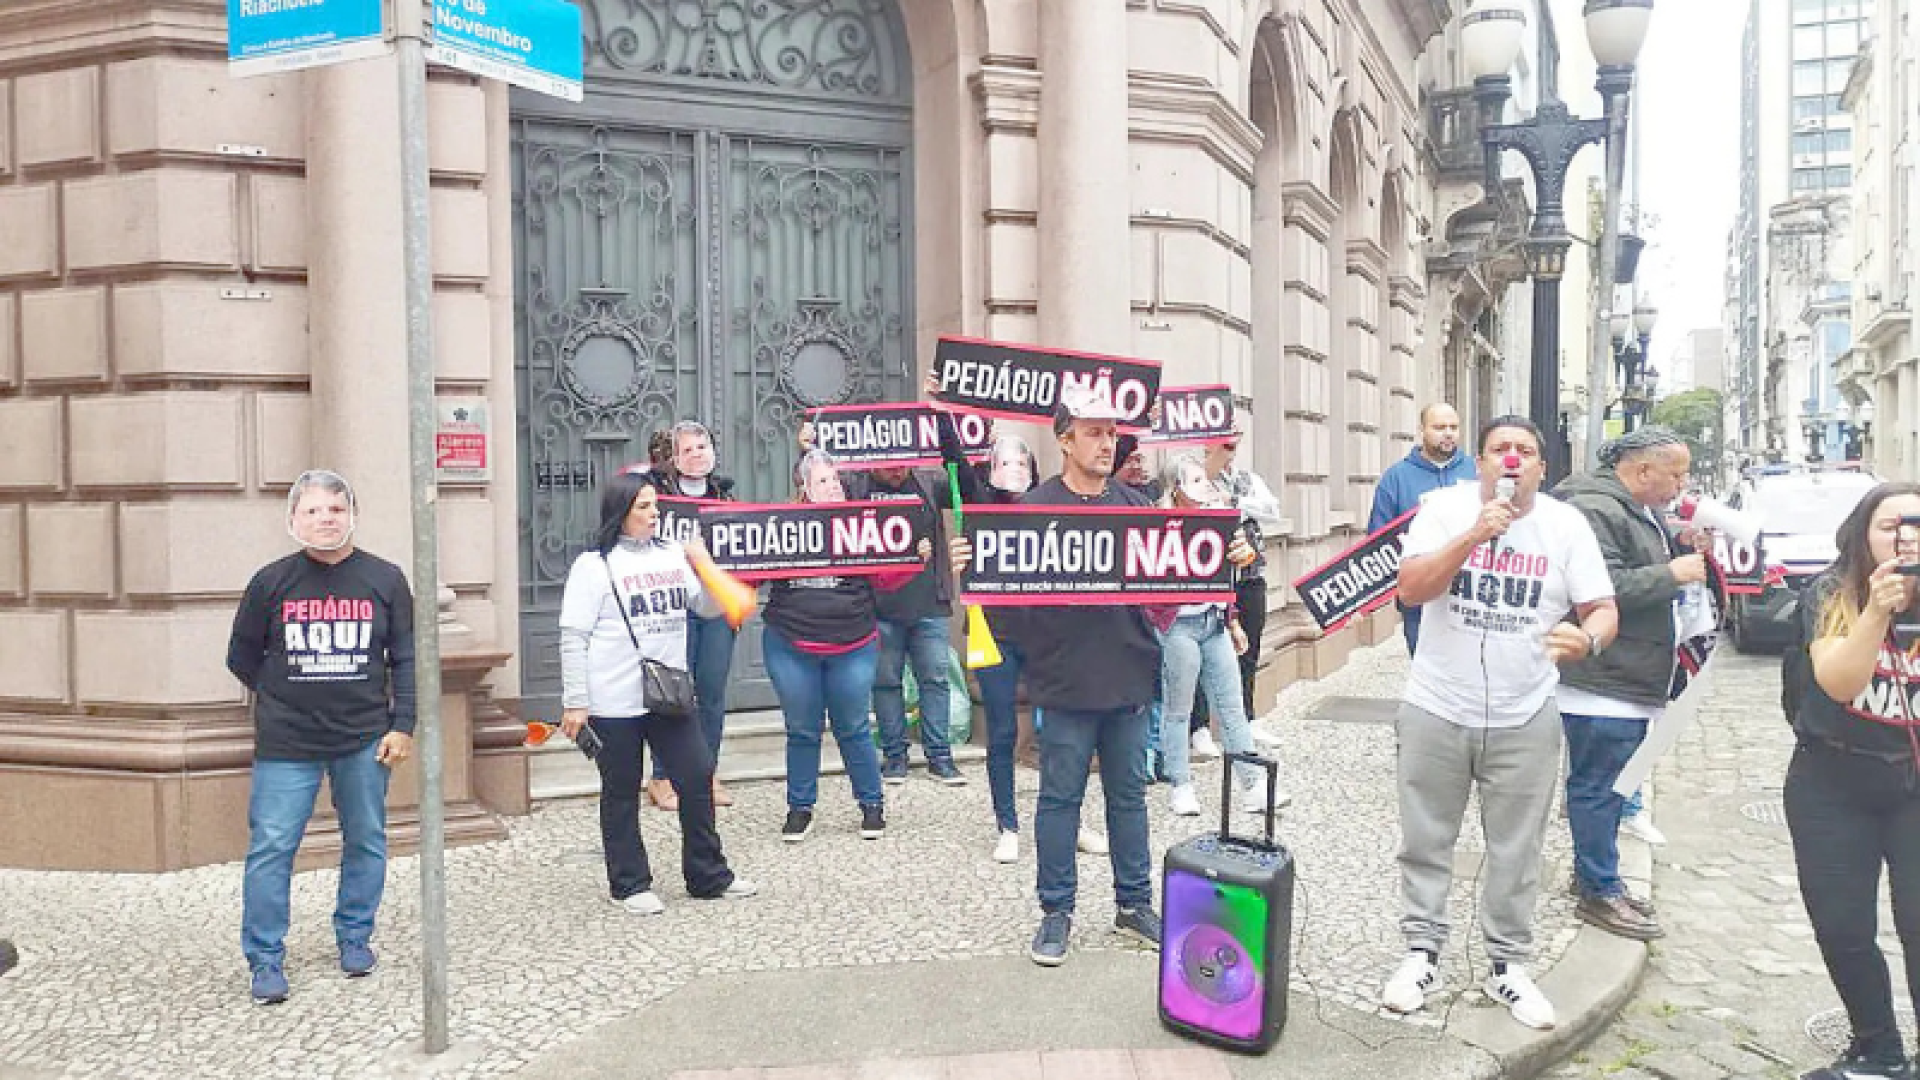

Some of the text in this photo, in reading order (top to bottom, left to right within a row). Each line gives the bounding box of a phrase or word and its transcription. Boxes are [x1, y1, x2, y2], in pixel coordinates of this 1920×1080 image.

[436, 5, 534, 52] Novembro
[941, 360, 1056, 407] PEDÁGIO
[817, 414, 985, 450] PEDÁGIO NO
[1165, 393, 1225, 431] NÃO
[712, 509, 914, 557] PEDÁGIO NÃO
[976, 518, 1226, 578] PEDÁGIO NÃO
[1308, 544, 1400, 613] PEDÁGIO
[1467, 543, 1549, 577] EDÁGIO
[282, 594, 373, 623] PEDÁGIO
[1450, 569, 1543, 609] AQUI
[284, 621, 373, 654] AQUI
